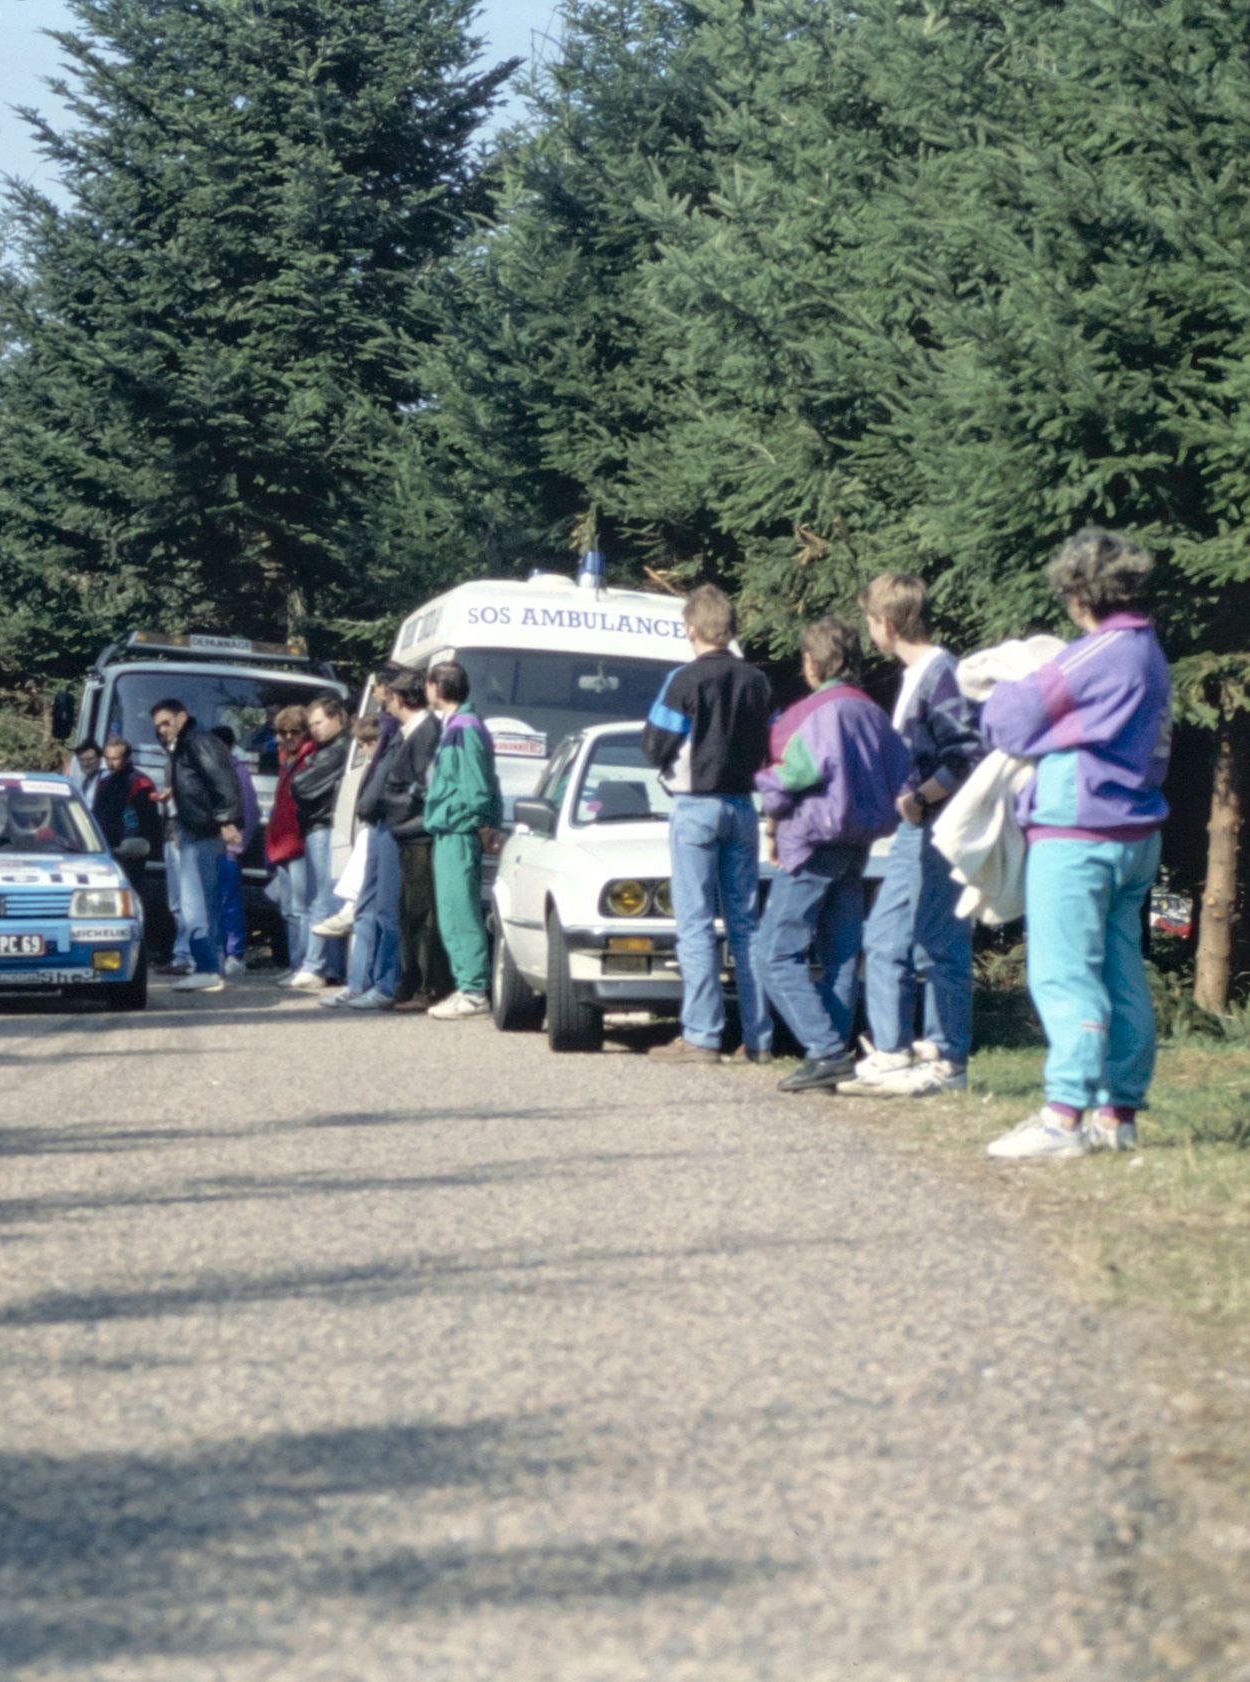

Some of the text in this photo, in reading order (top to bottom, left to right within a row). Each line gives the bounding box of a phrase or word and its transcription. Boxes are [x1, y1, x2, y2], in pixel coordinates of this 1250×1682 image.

[467, 606, 687, 640] SOS AMBULANCE
[71, 927, 129, 938] MICHELIN
[22, 935, 41, 953] 69
